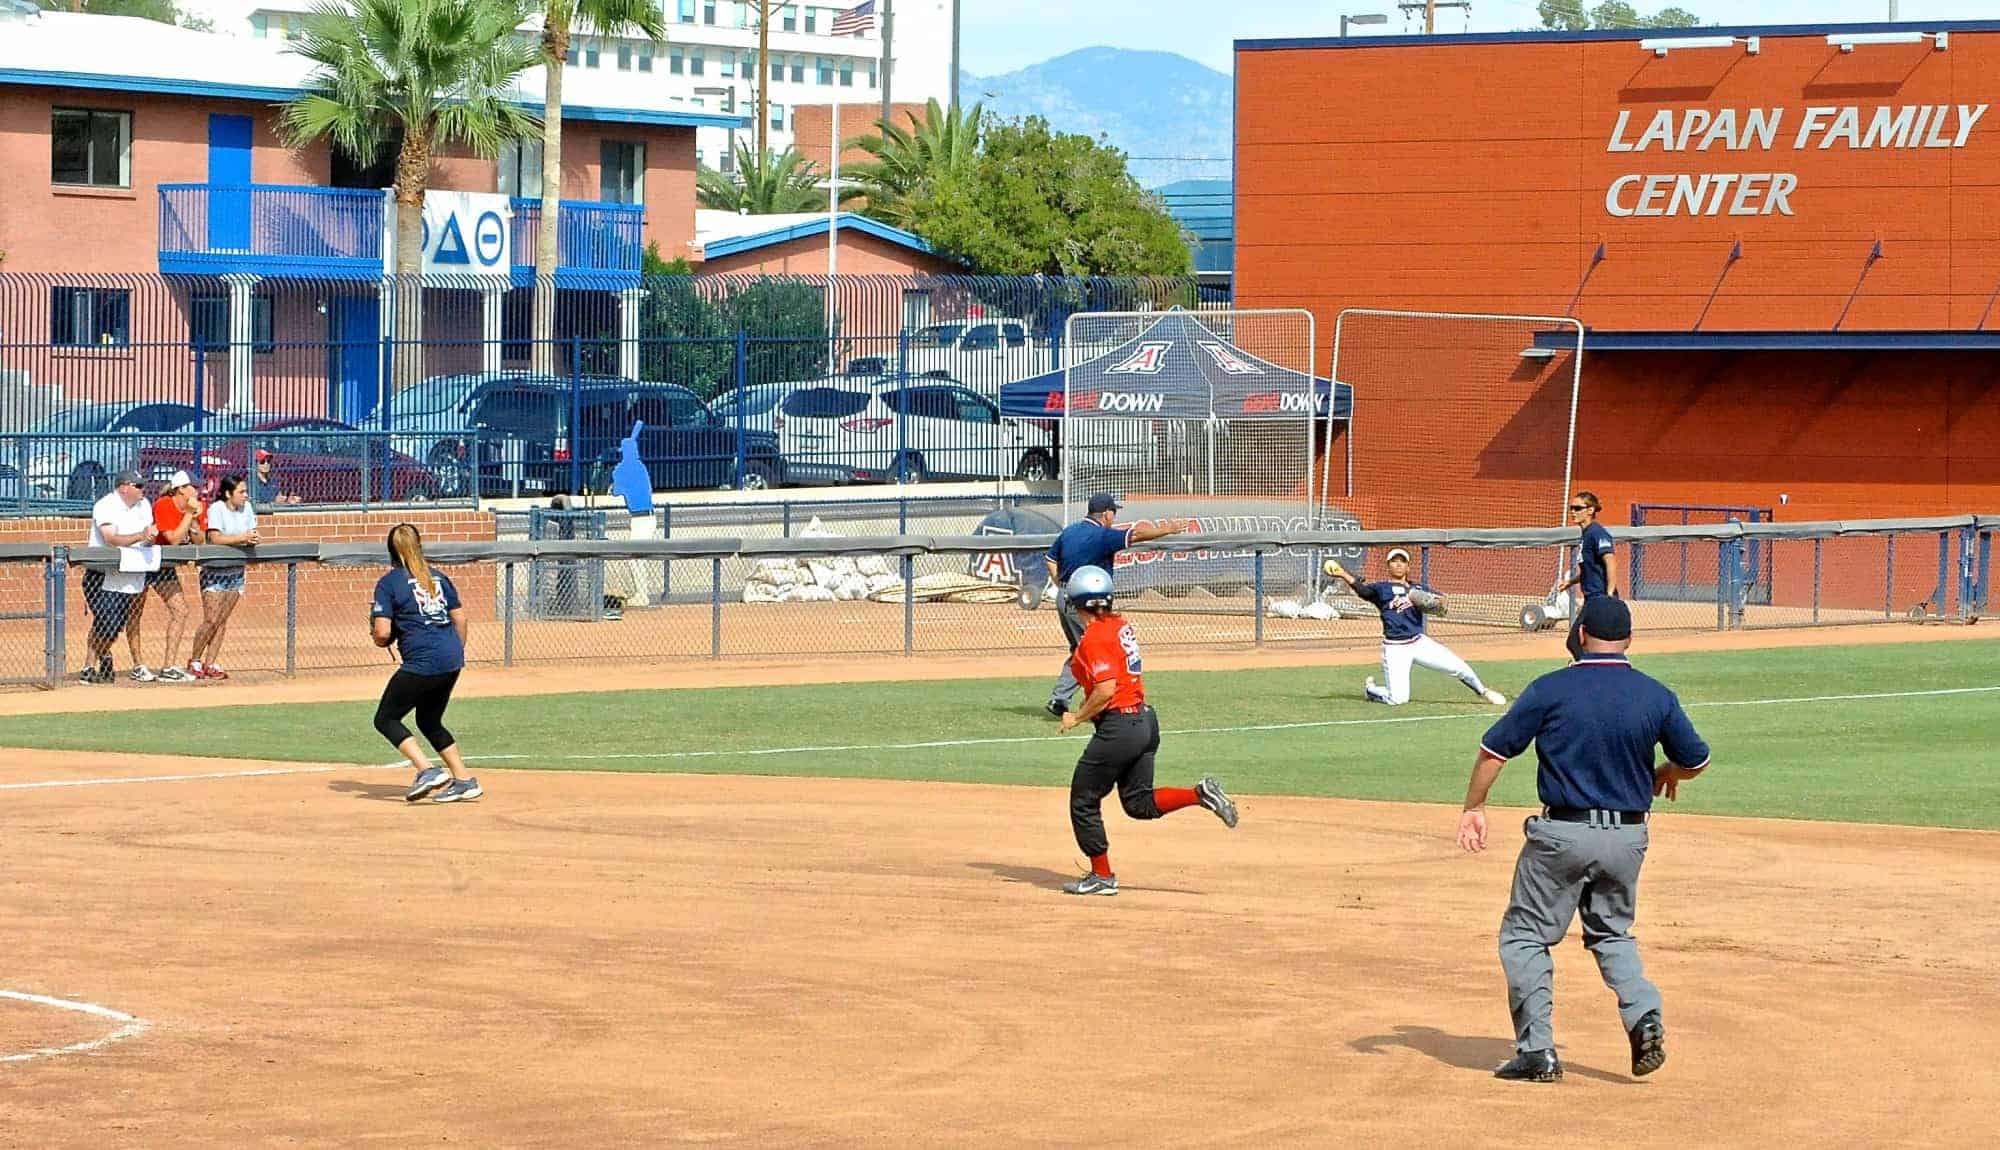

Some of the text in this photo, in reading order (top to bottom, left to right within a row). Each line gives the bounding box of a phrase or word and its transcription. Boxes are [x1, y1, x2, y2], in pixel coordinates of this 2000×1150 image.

[1607, 104, 1989, 152] LAPAN FAMILY
[1605, 173, 1798, 217] CENTER
[421, 210, 505, 267] ΔΘ
[1098, 391, 1163, 412] DOWN
